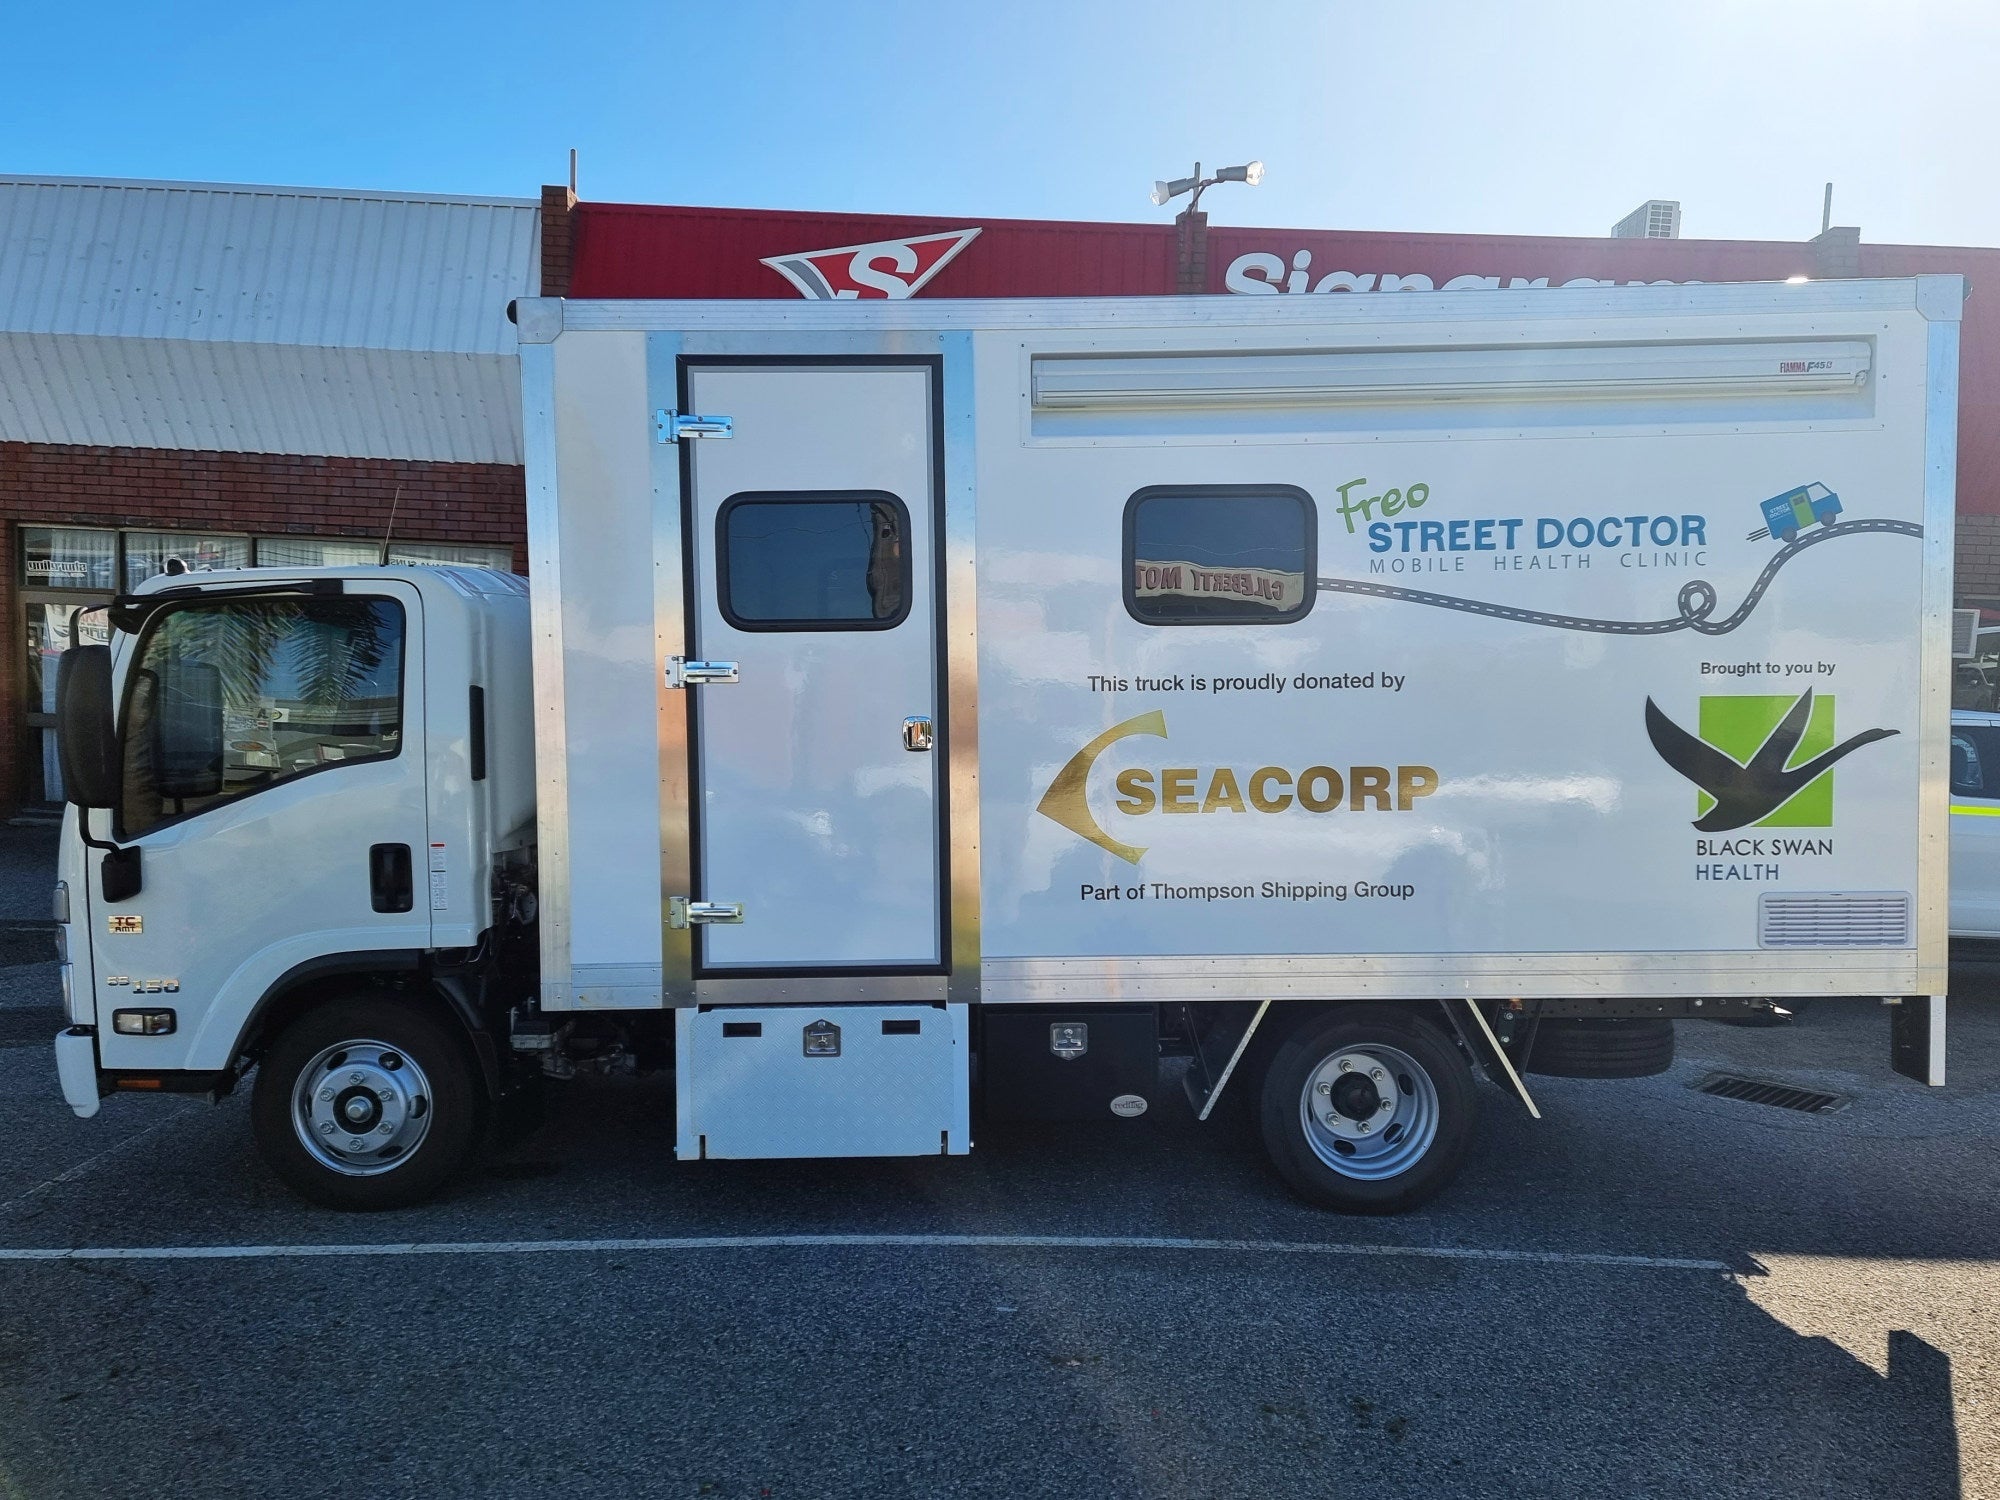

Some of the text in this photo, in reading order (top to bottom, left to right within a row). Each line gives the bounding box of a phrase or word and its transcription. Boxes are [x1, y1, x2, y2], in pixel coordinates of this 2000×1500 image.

[1336, 478, 1429, 533] Freo
[1368, 515, 1707, 553] STREET DOCTOR
[1369, 551, 1707, 573] MOBILE HEALTH CLINIC
[1701, 661, 1836, 677] Brought to you by
[1087, 671, 1405, 694] This truck is proudly donated by
[1115, 765, 1439, 815] SEACORP
[1696, 839, 1833, 856] BLACK SWAN
[1696, 864, 1779, 880] HEALTH
[1081, 881, 1414, 902] Part of Thompson Shipping Group
[115, 917, 135, 926] TC
[132, 979, 180, 994] 150
